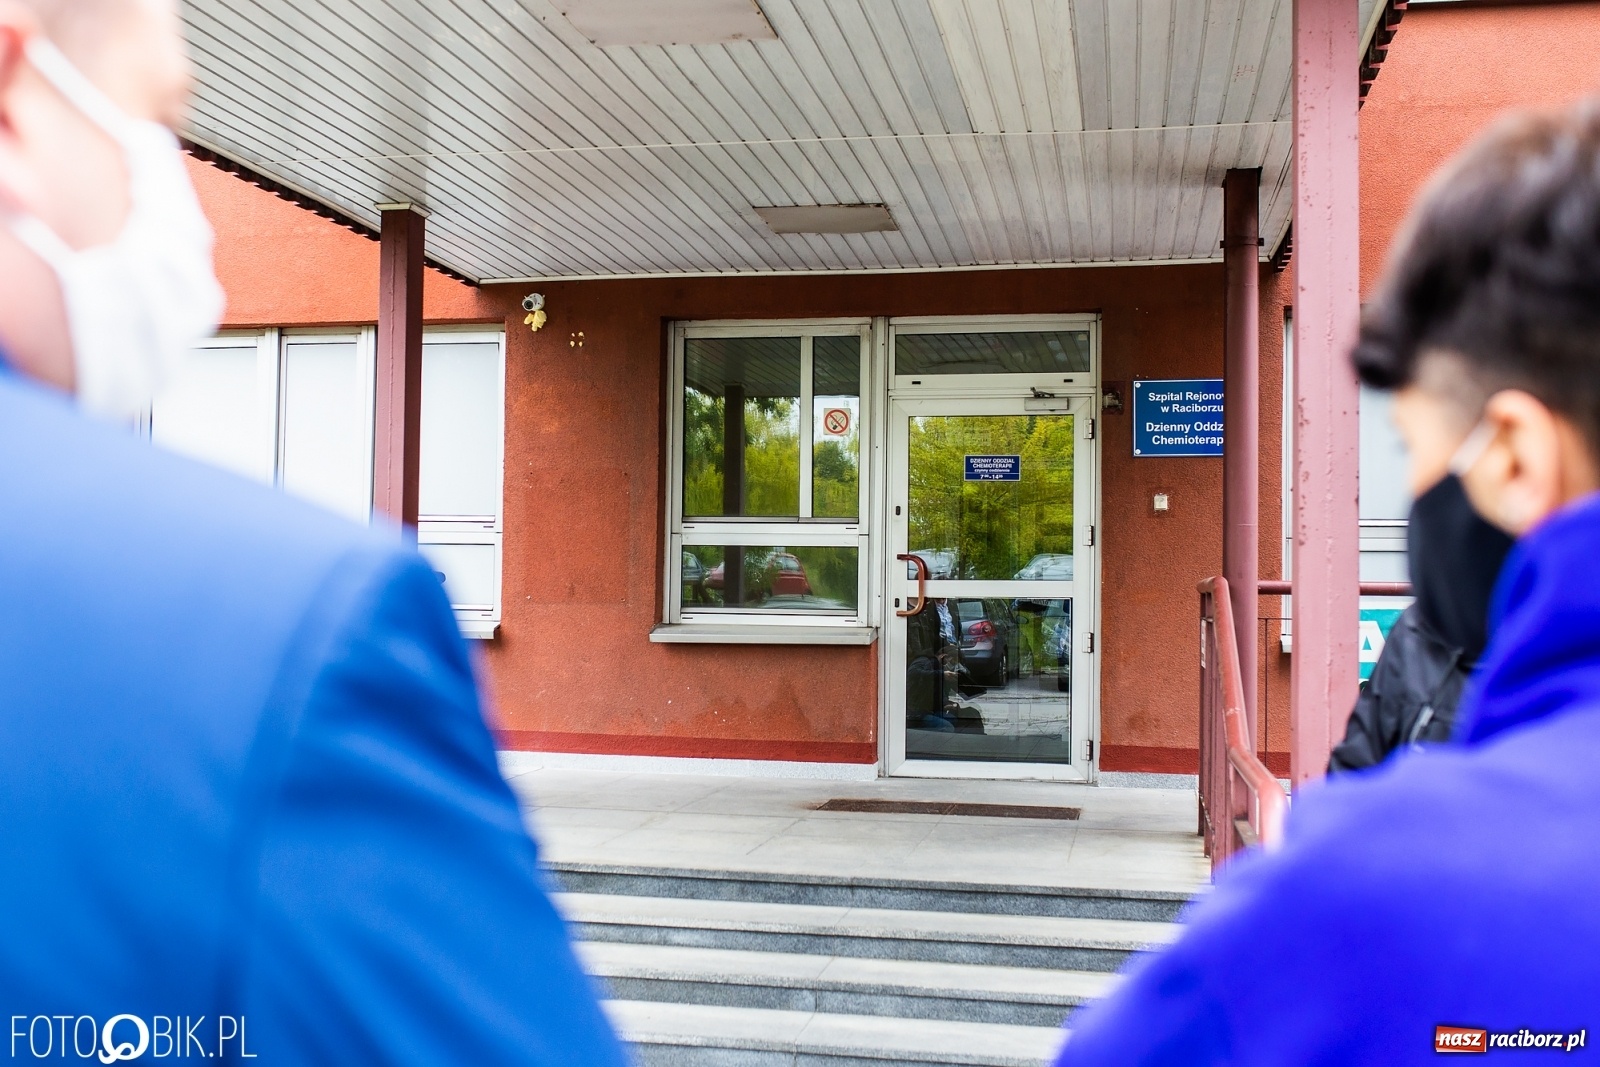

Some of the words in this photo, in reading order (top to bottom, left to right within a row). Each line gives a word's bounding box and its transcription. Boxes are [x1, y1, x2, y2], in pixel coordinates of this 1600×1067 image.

[1148, 392, 1183, 403] Szpital
[1185, 391, 1224, 403] Rejono
[1172, 403, 1224, 412] Raciborzu
[1146, 422, 1191, 434] Dzienny
